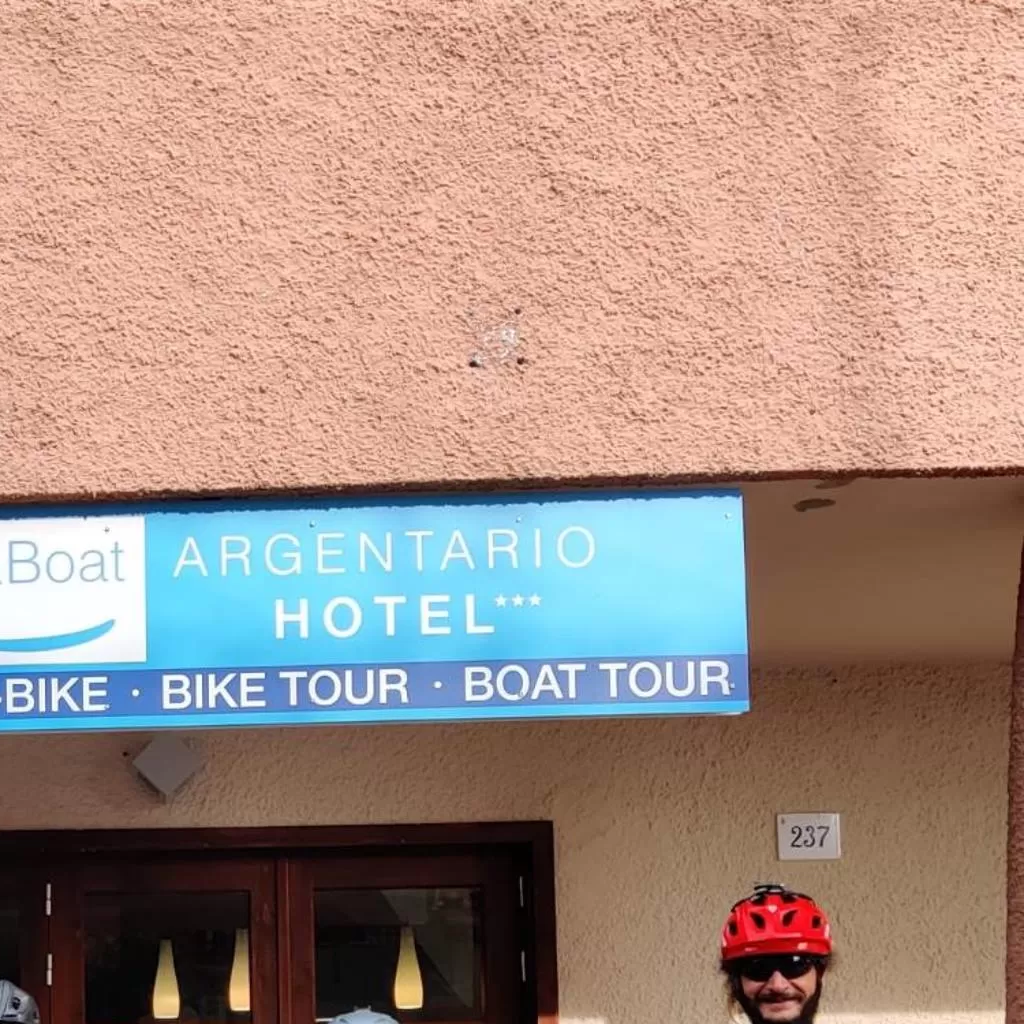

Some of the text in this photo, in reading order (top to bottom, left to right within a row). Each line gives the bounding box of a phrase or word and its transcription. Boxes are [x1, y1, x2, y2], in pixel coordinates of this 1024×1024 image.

[173, 526, 597, 578] ARGENTARIO
[161, 672, 265, 710] BIKE
[279, 668, 409, 706] TOUR
[464, 663, 585, 702] BOAT
[598, 660, 732, 698] TOUR
[790, 825, 830, 848] 237
